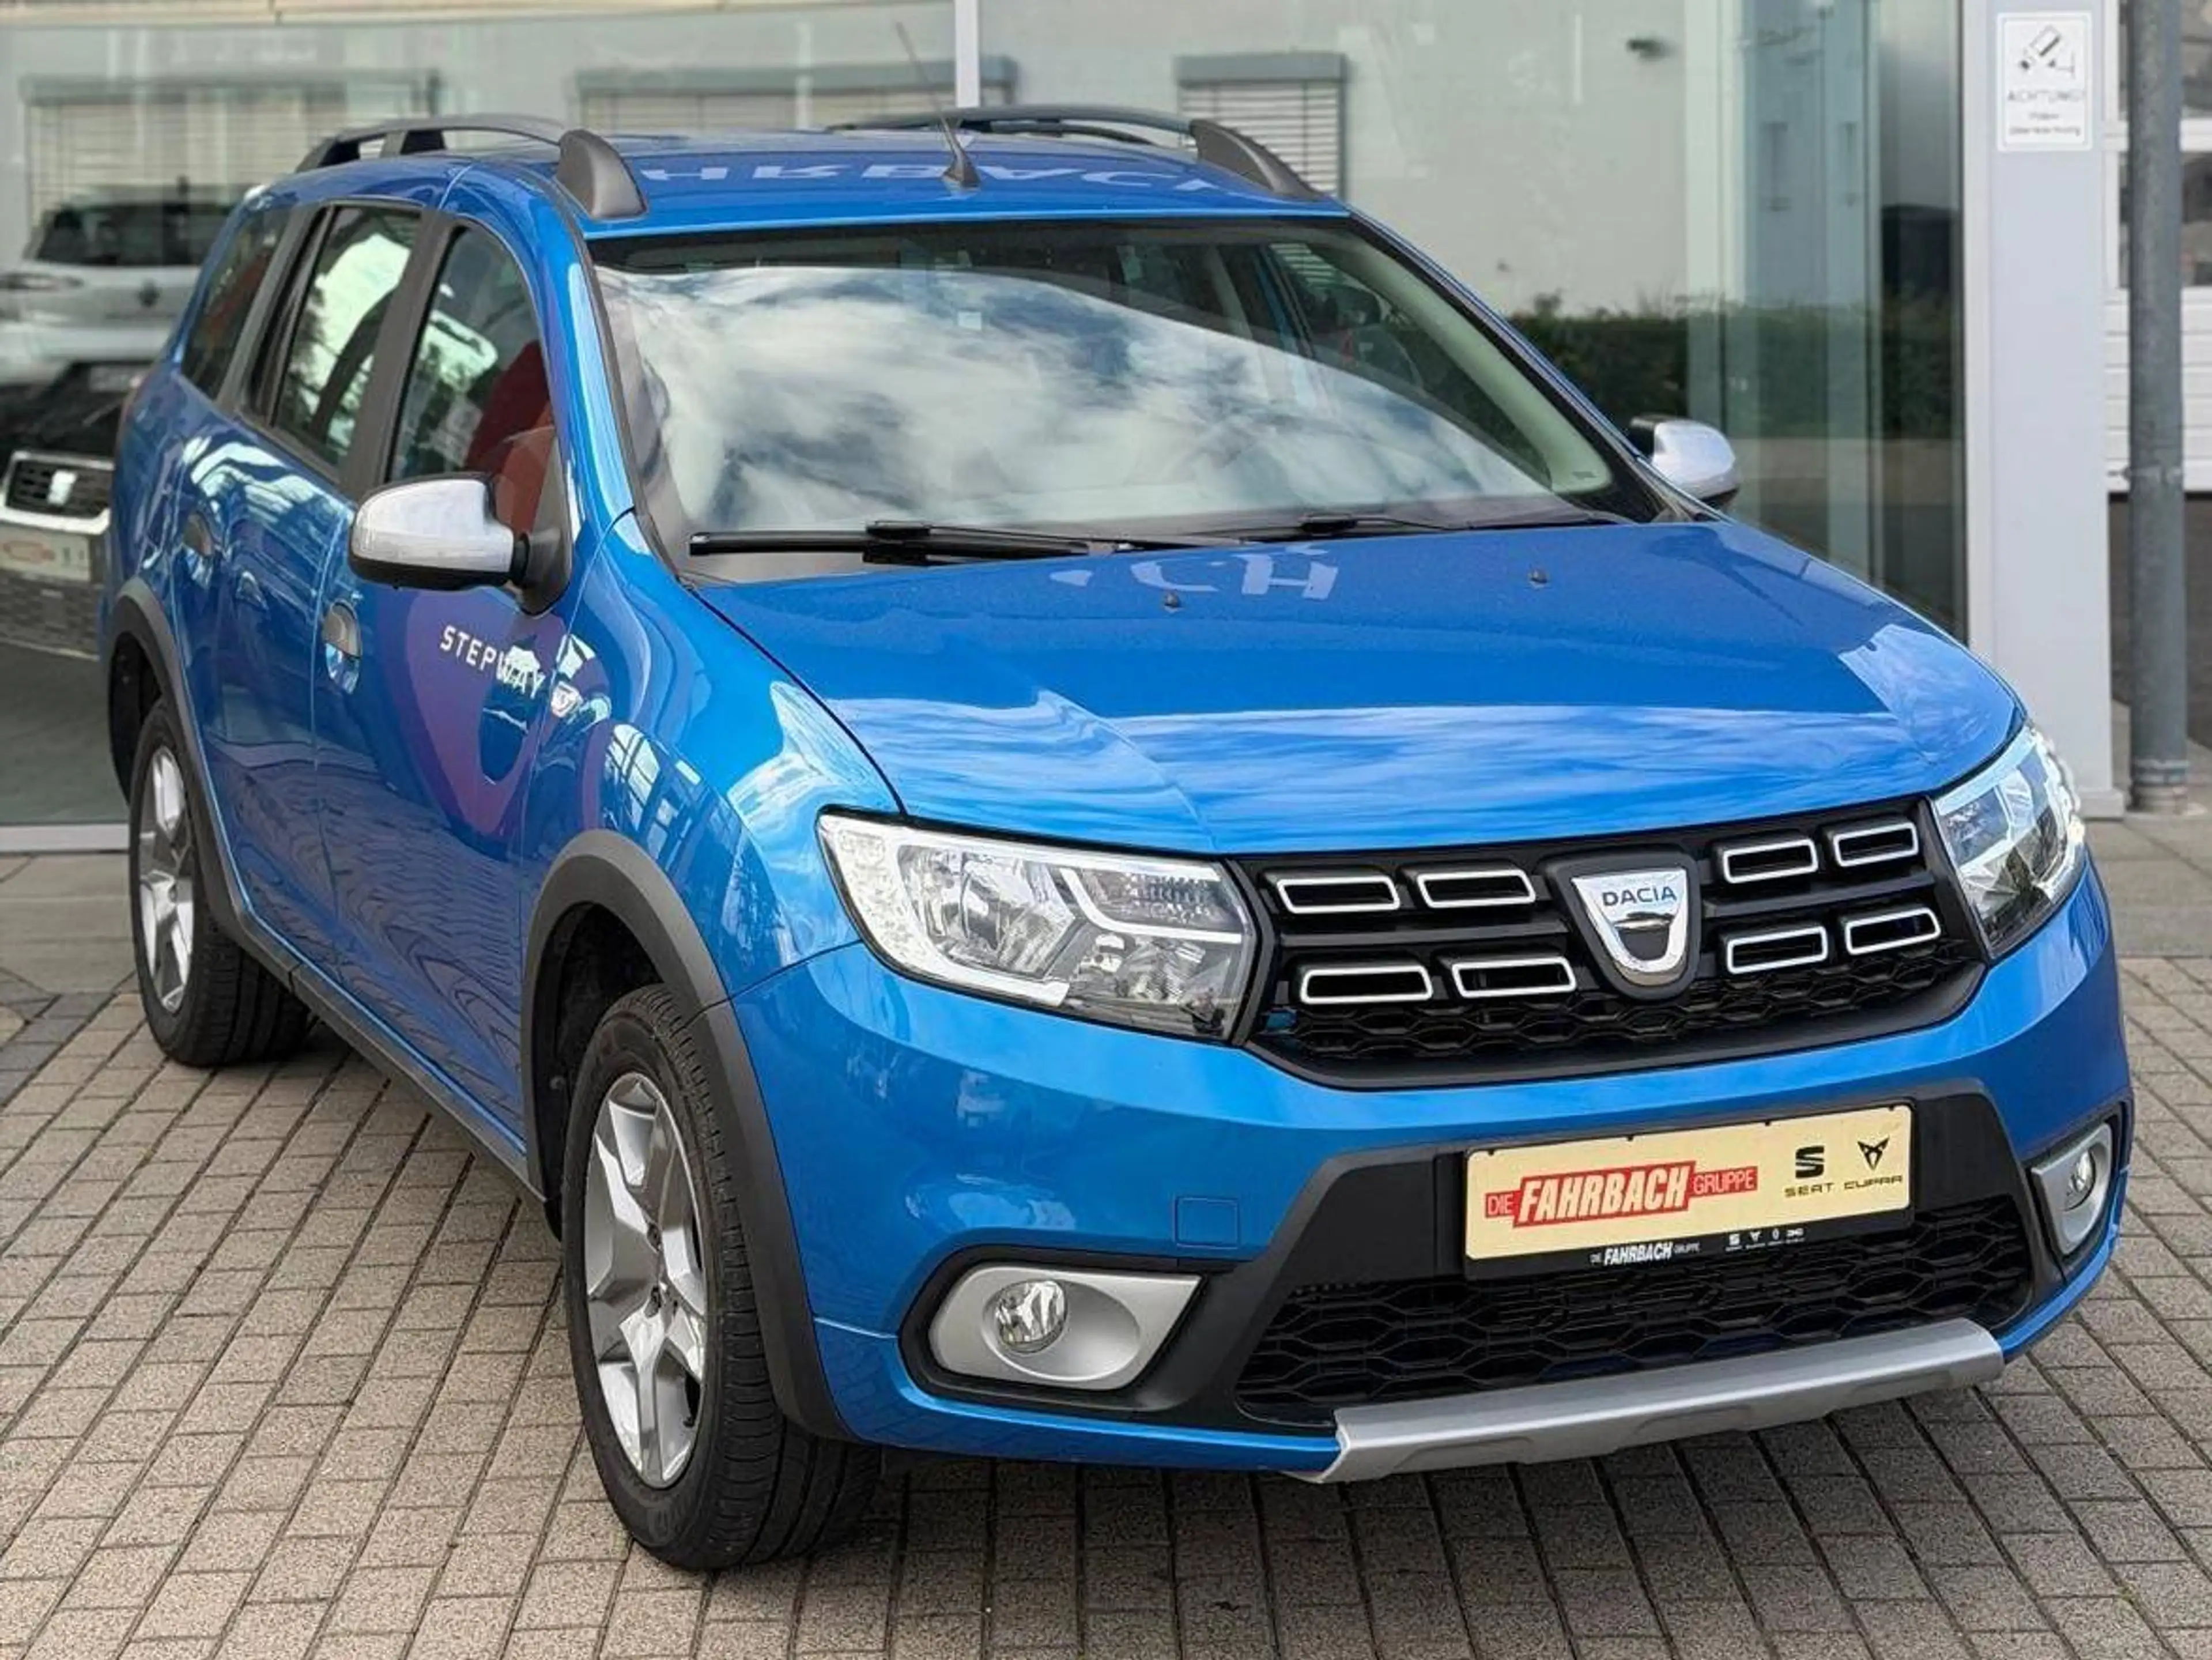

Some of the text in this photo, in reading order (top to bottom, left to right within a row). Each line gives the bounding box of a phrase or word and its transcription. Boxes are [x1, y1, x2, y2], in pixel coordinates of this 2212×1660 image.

[440, 625, 545, 699] STEPWAY
[1602, 886, 1677, 906] DACIA
[1488, 1165, 1756, 1223] DIE FAHRBACH GRUPPE
[1784, 1175, 1903, 1198] SEAT CUPRA
[1603, 1242, 1674, 1266] FAHRBACH
